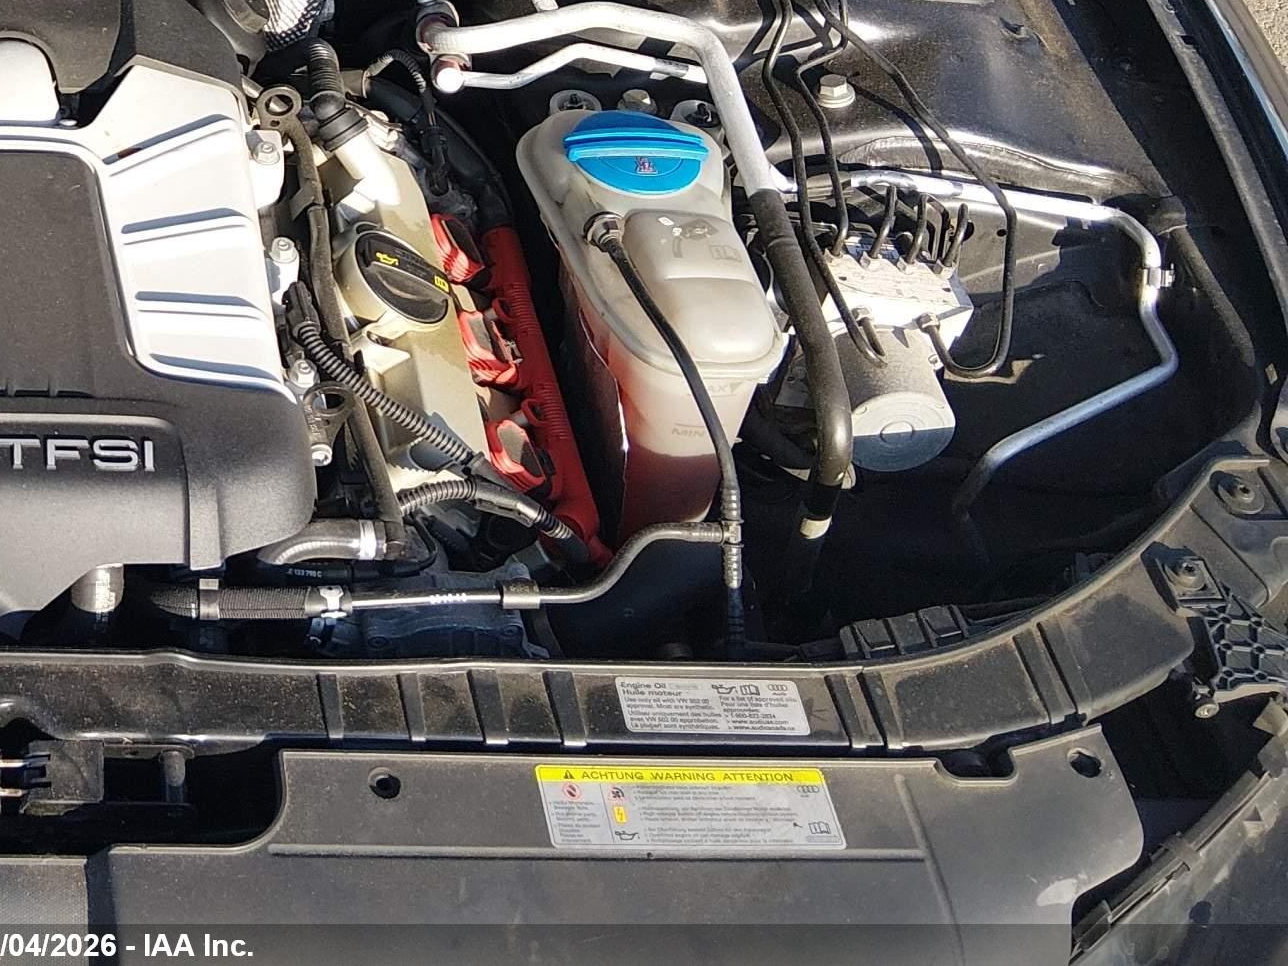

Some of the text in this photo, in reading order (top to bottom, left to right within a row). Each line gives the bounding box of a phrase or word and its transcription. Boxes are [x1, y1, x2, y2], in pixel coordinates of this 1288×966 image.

[581, 771, 794, 782] ACHTUNG WARNING ATTENTION
